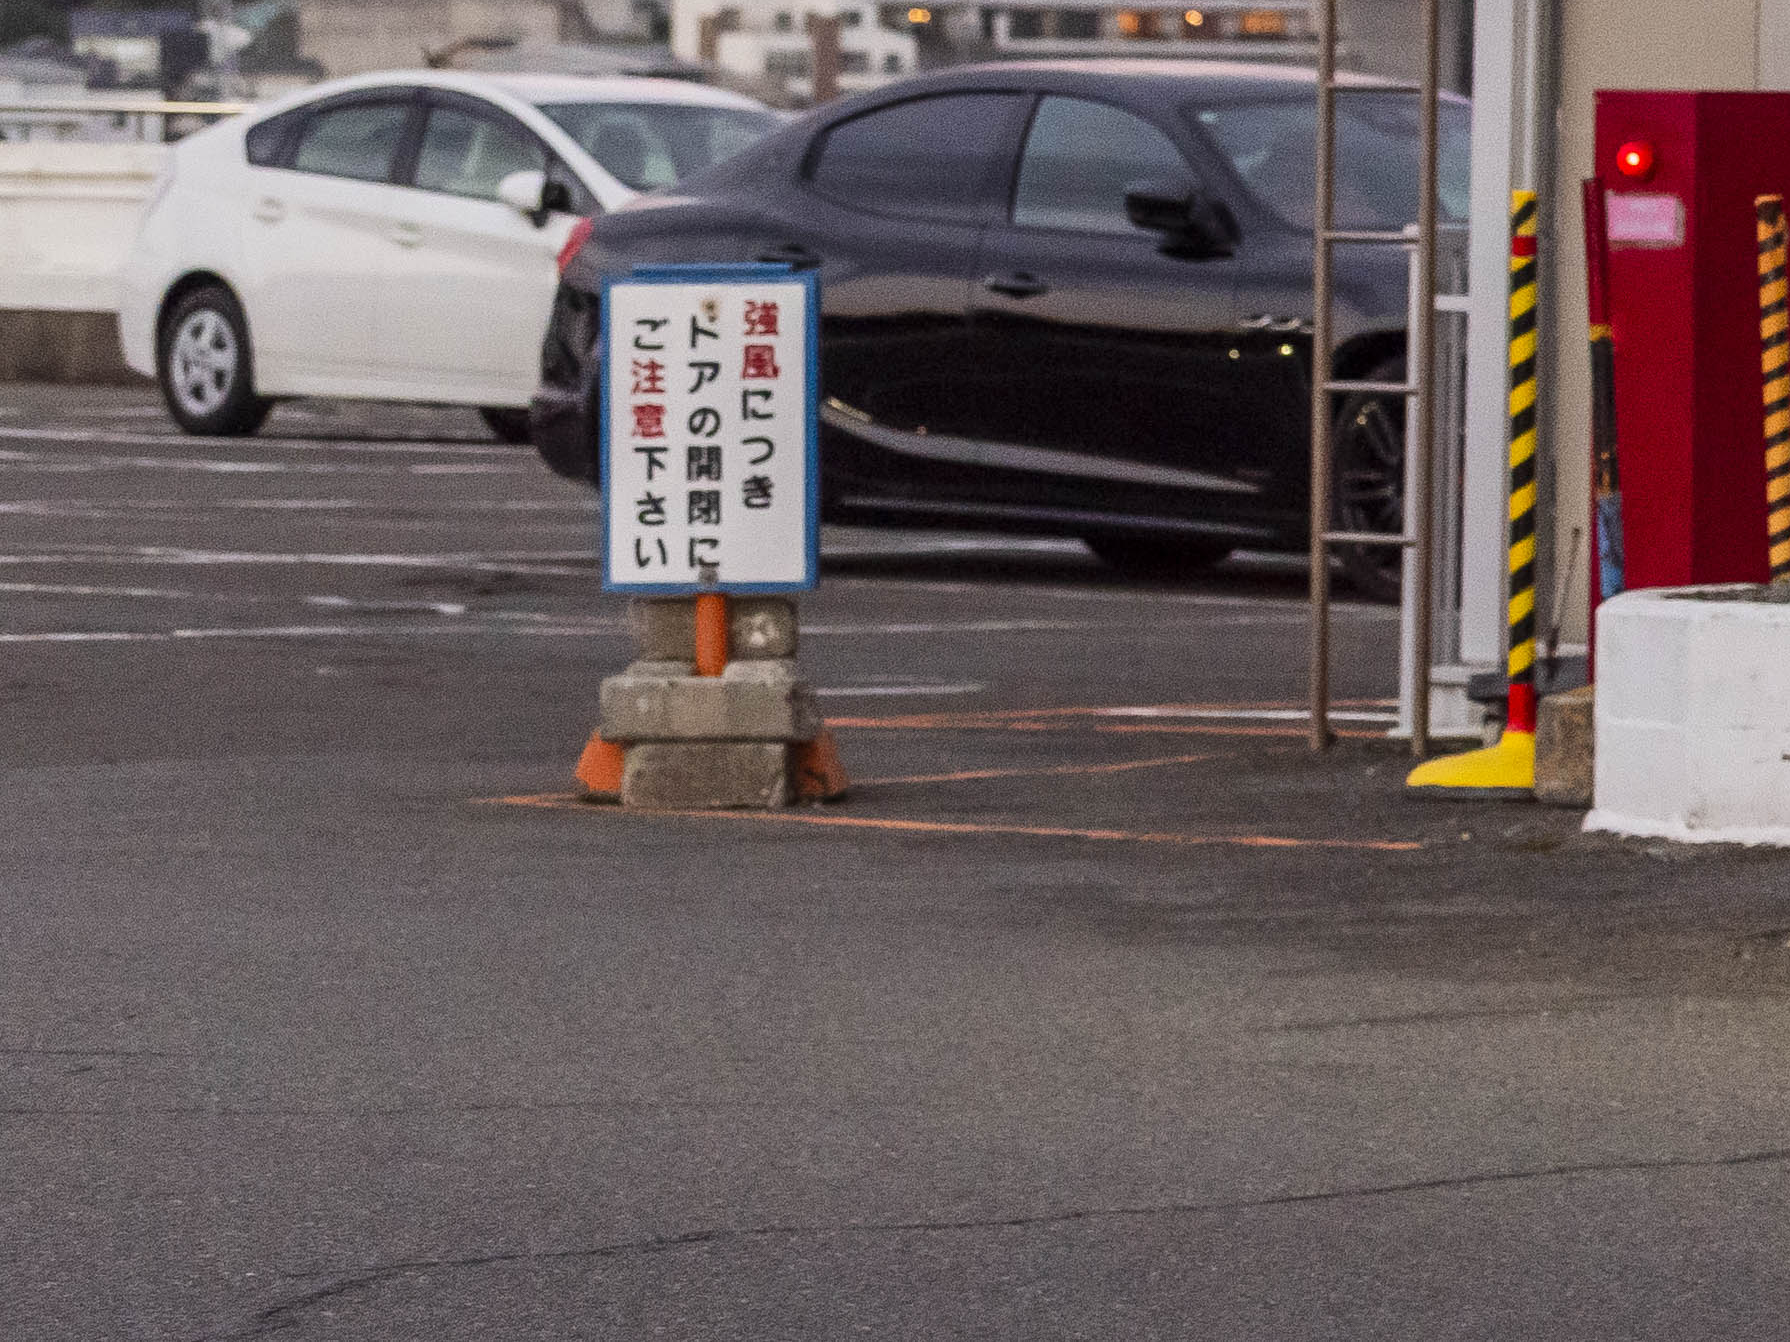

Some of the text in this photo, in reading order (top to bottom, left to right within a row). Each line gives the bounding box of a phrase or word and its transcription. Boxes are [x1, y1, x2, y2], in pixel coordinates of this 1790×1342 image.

[630, 318, 669, 568] ご注意下さい
[741, 299, 780, 510] 強風につき
